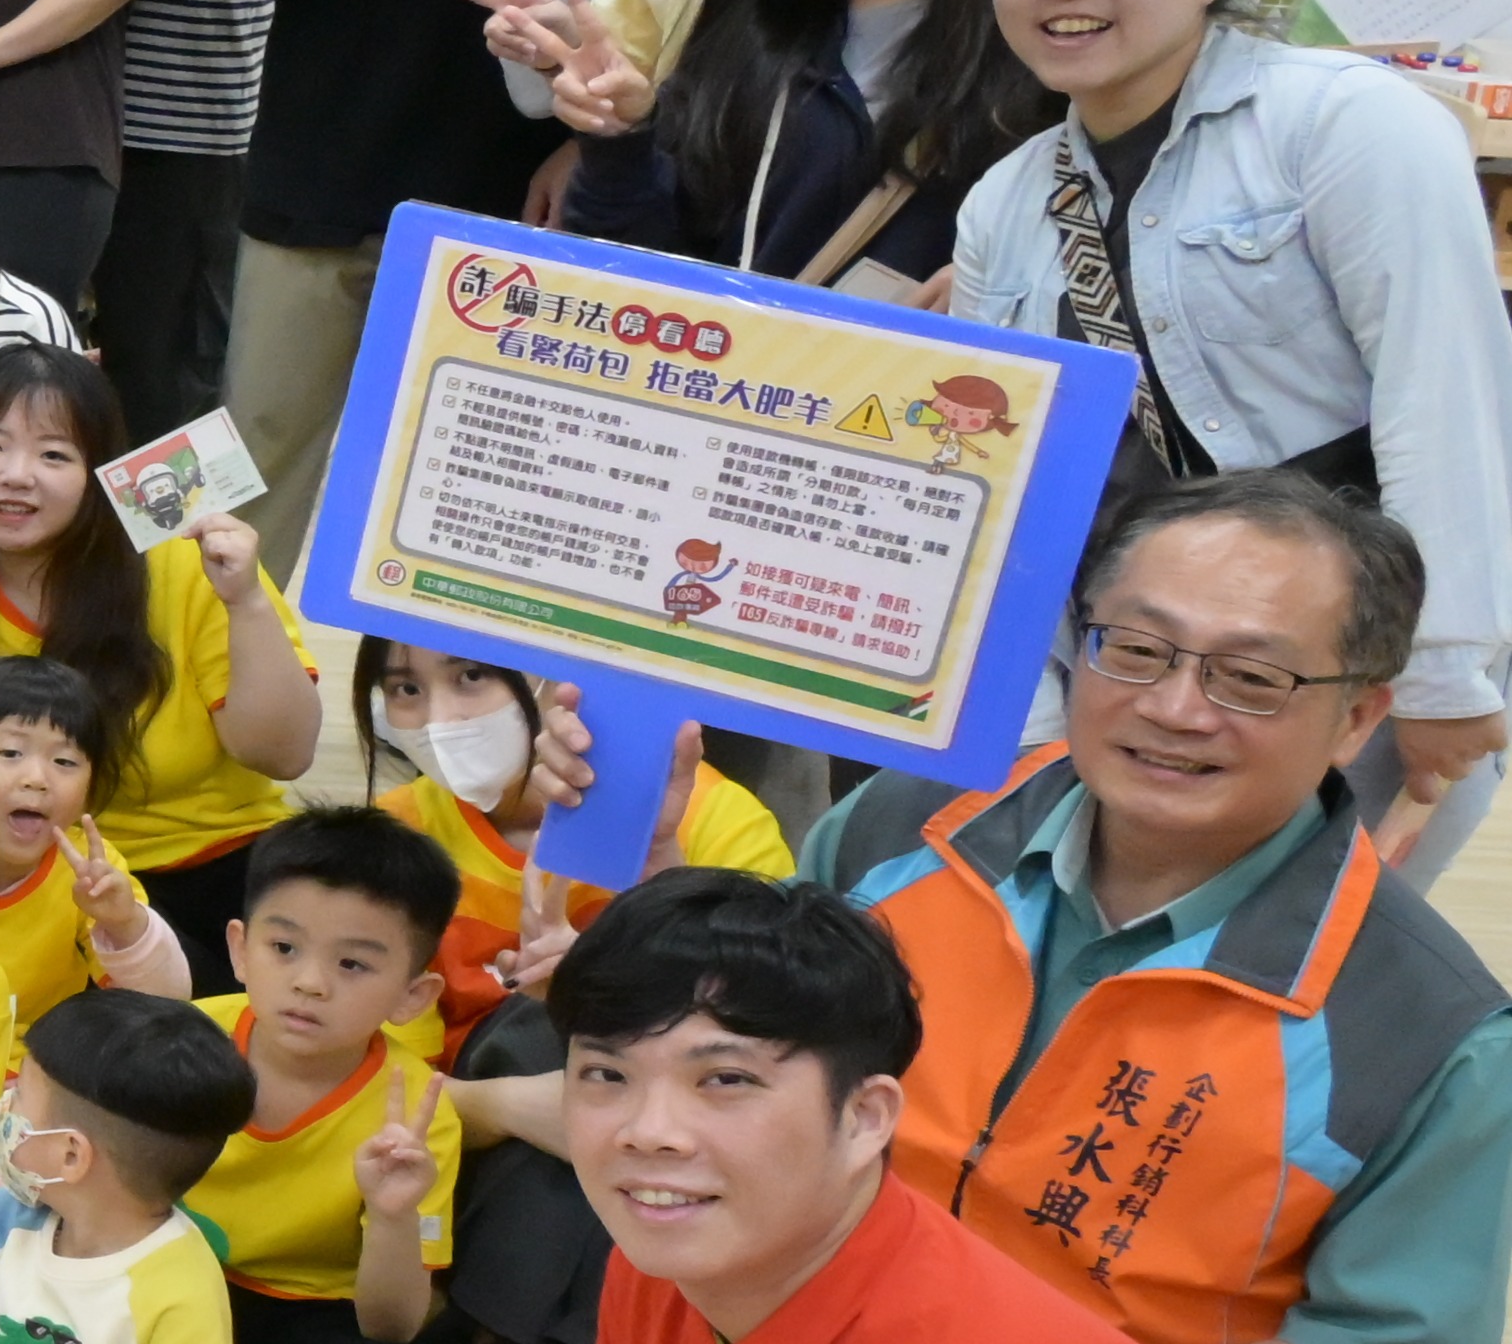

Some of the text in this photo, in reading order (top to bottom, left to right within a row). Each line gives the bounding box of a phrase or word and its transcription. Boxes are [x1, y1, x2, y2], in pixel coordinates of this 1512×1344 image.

[459, 262, 727, 357] 詐騙手法停看聽
[496, 328, 834, 428] 看緊荷包 拒當大肥羊
[1086, 1072, 1219, 1290] 企劃行銷科科長
